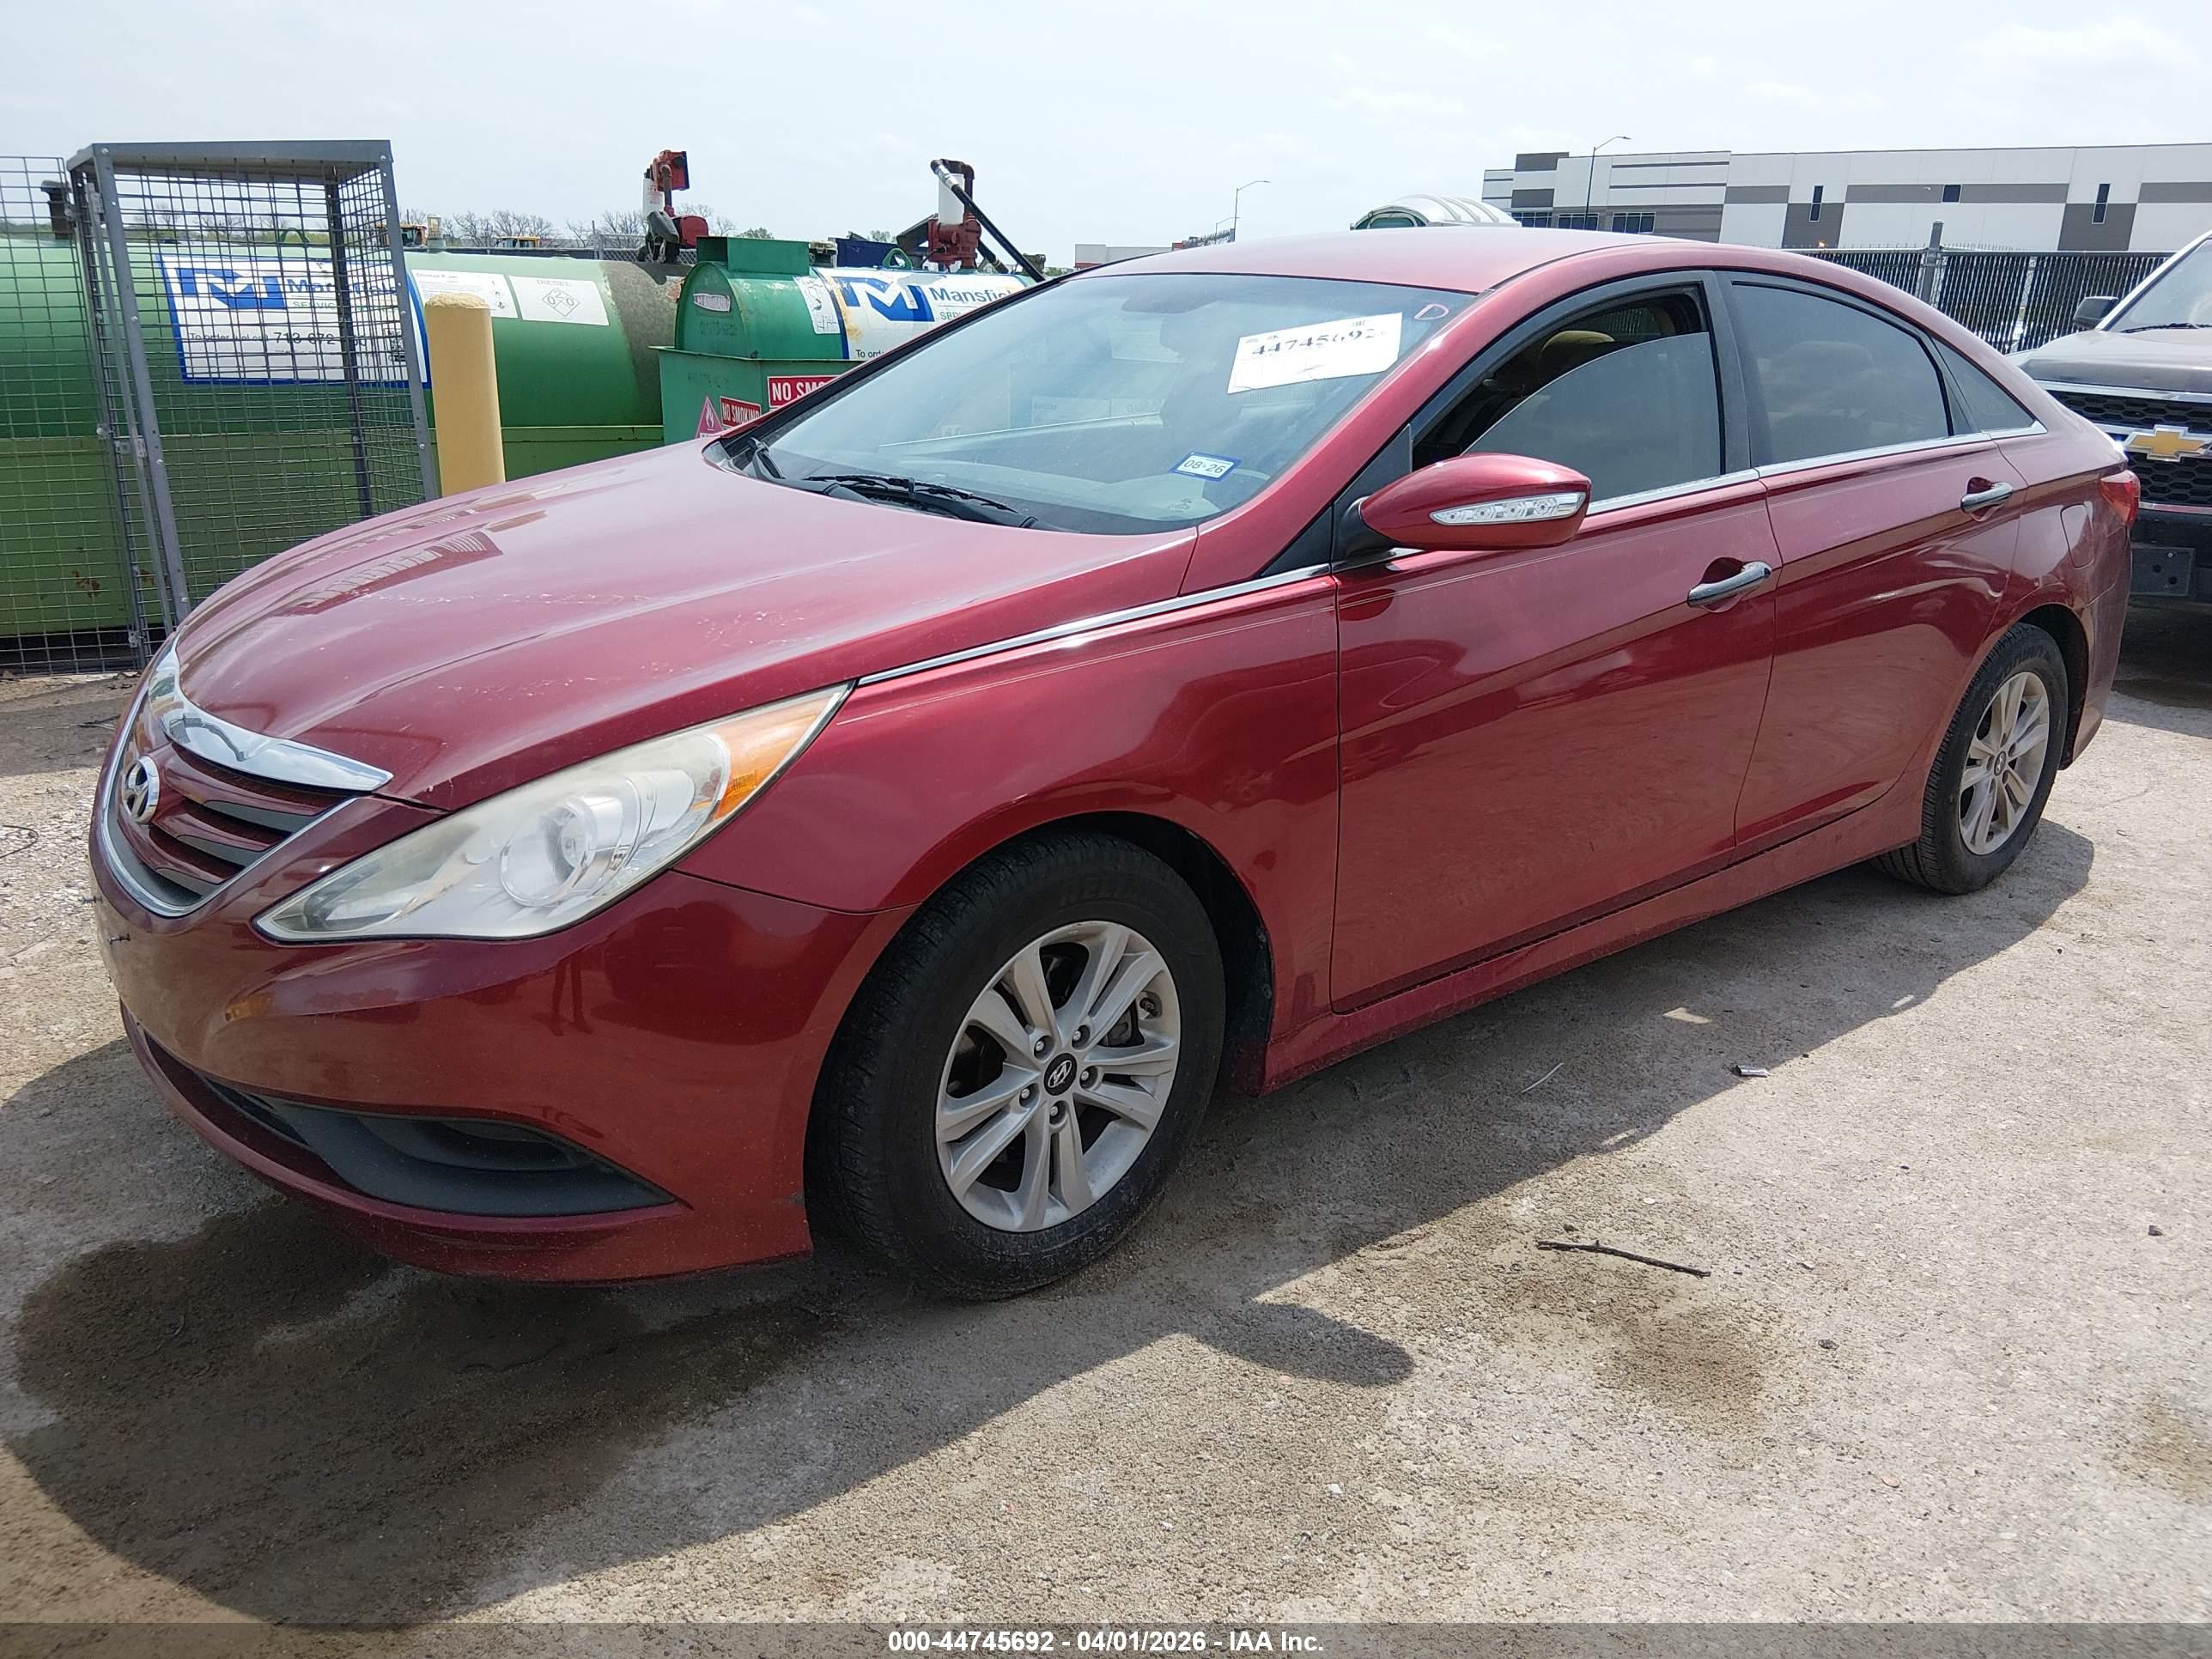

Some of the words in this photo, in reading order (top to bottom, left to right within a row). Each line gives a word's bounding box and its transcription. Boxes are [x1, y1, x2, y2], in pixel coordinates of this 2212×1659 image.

[855, 349, 866, 358] To
[867, 349, 883, 358] ord
[771, 381, 792, 401] NO
[722, 402, 731, 421] NO
